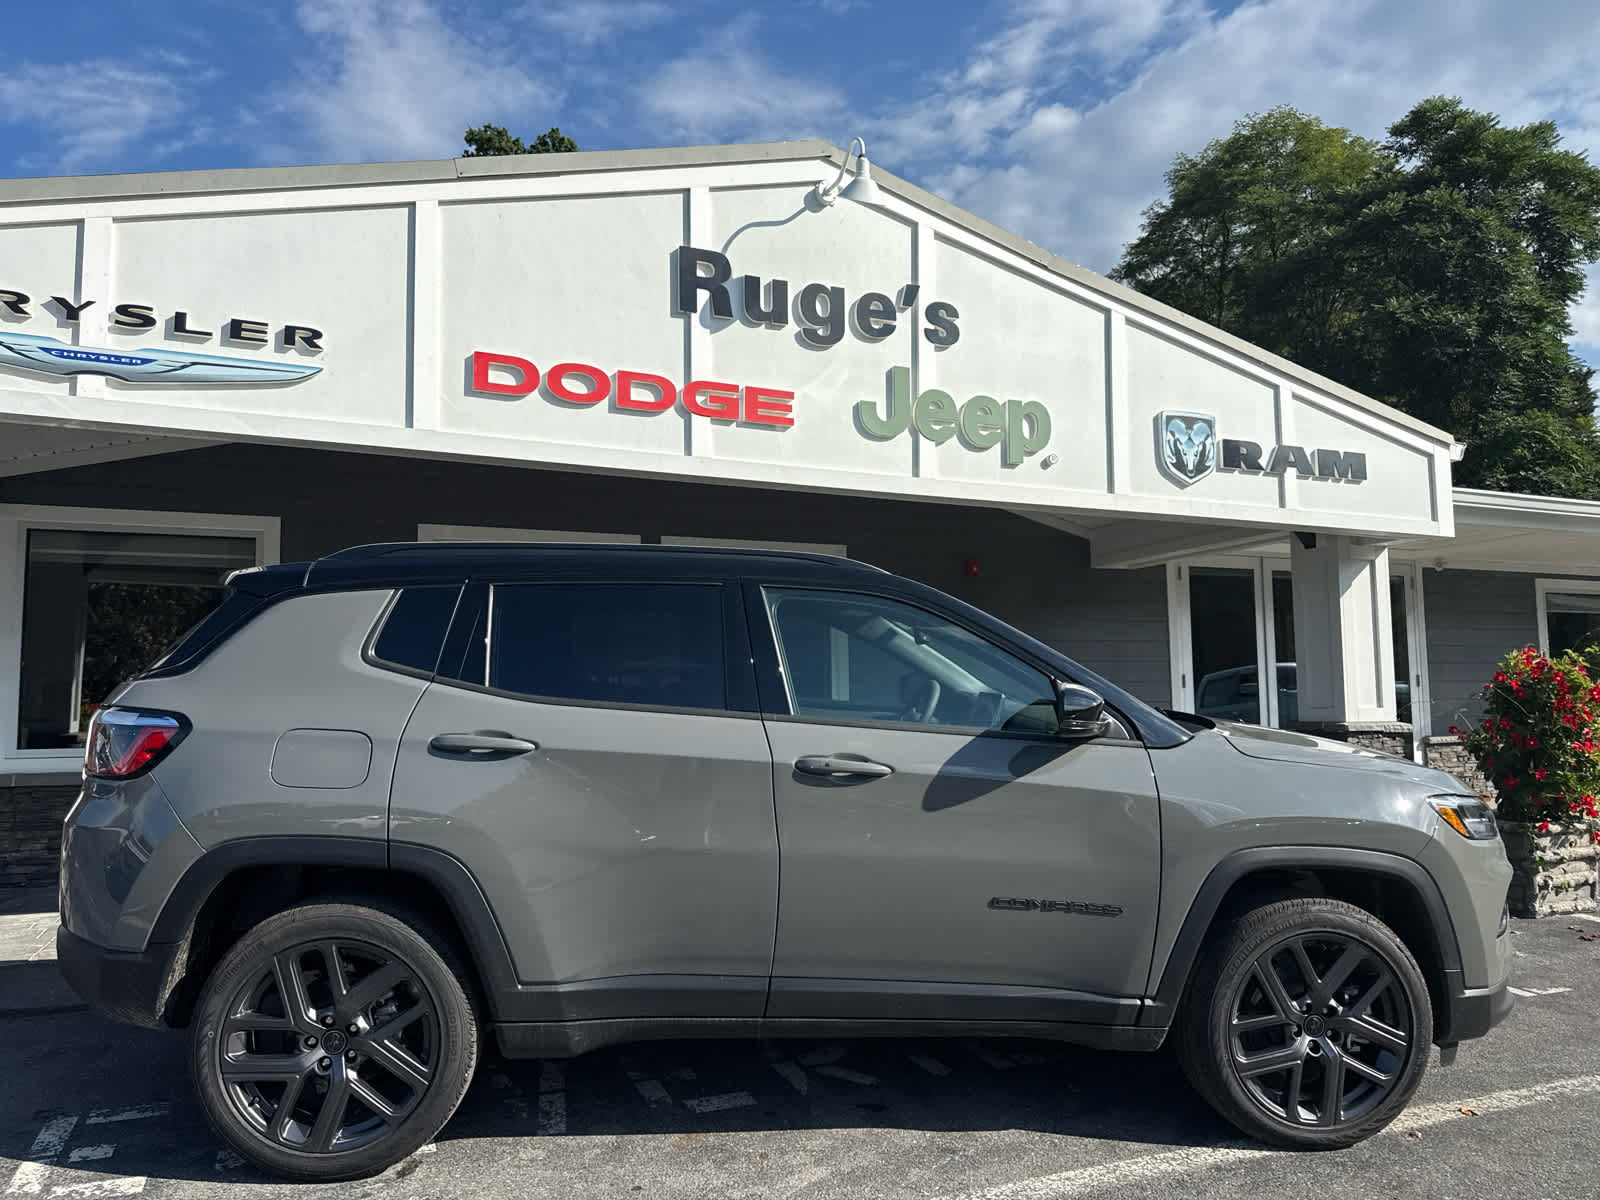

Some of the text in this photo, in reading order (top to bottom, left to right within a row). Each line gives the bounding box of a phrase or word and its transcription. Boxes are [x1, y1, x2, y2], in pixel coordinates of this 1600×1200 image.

[672, 245, 961, 349] Ruge's
[50, 350, 143, 365] CHRYSLER
[469, 350, 795, 428] DODGE
[856, 366, 1052, 467] Jeep
[1219, 438, 1368, 482] RAM
